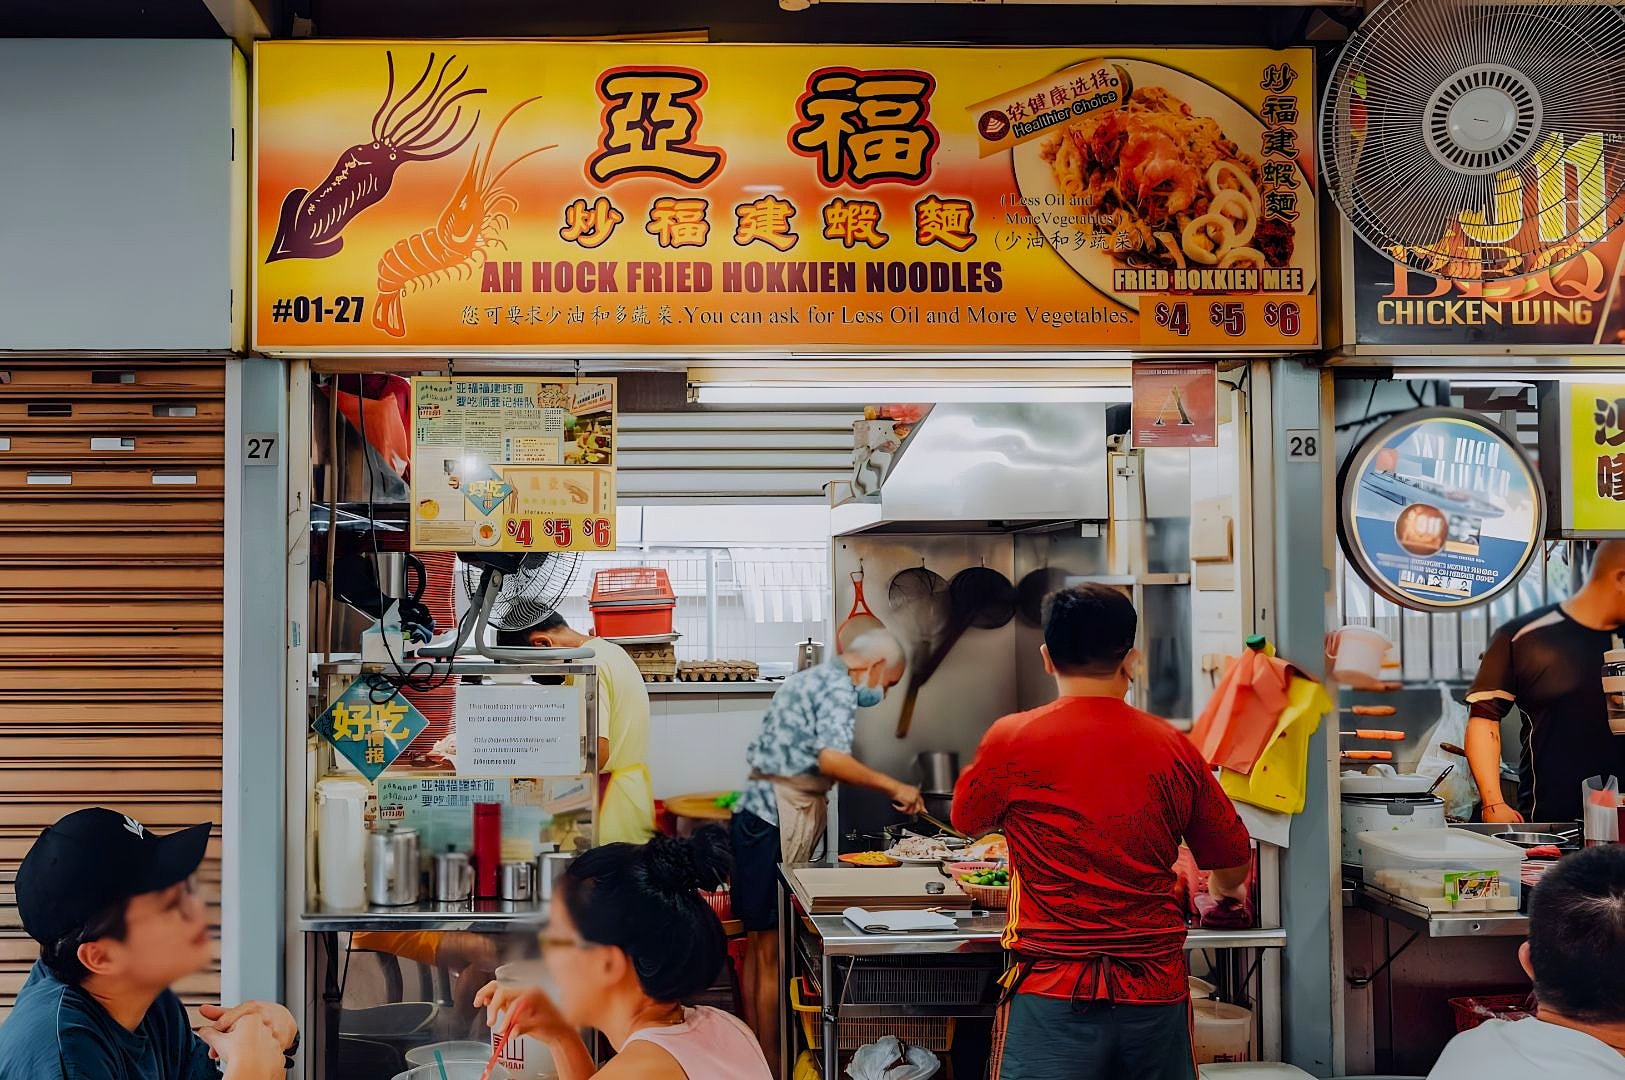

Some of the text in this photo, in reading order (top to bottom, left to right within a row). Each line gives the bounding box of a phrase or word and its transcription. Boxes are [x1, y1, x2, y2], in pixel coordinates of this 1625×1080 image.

[584, 66, 936, 189] 亞福
[1013, 90, 1118, 138] Healthier Choice
[1260, 62, 1301, 223] 炒福建蝦麵
[1010, 193, 1040, 206] Less
[1044, 193, 1065, 206] Oil
[1069, 193, 1094, 206] and
[559, 194, 977, 251] 炒福建蝦麵
[480, 260, 1004, 293] AH HOCK FRIED HOKKIEN NOODLES
[1114, 269, 1303, 292] FRIED HOKKIEN MEE
[272, 296, 364, 323] #01-27
[730, 311, 763, 324] can
[769, 306, 800, 324] ask
[807, 305, 835, 324] for
[841, 306, 884, 324] Less
[890, 306, 920, 324] Oil
[926, 306, 960, 324] and
[967, 306, 1018, 324] More
[1025, 306, 1134, 327] Vegetables.
[1155, 301, 1301, 336] $4 $5 $6
[1377, 300, 1592, 325] CHICKEN WING
[247, 438, 275, 459] 27
[1291, 436, 1317, 456] 28
[506, 518, 612, 547] $4 $5 $6
[331, 700, 411, 742] 好吃
[364, 730, 386, 764] 情报
